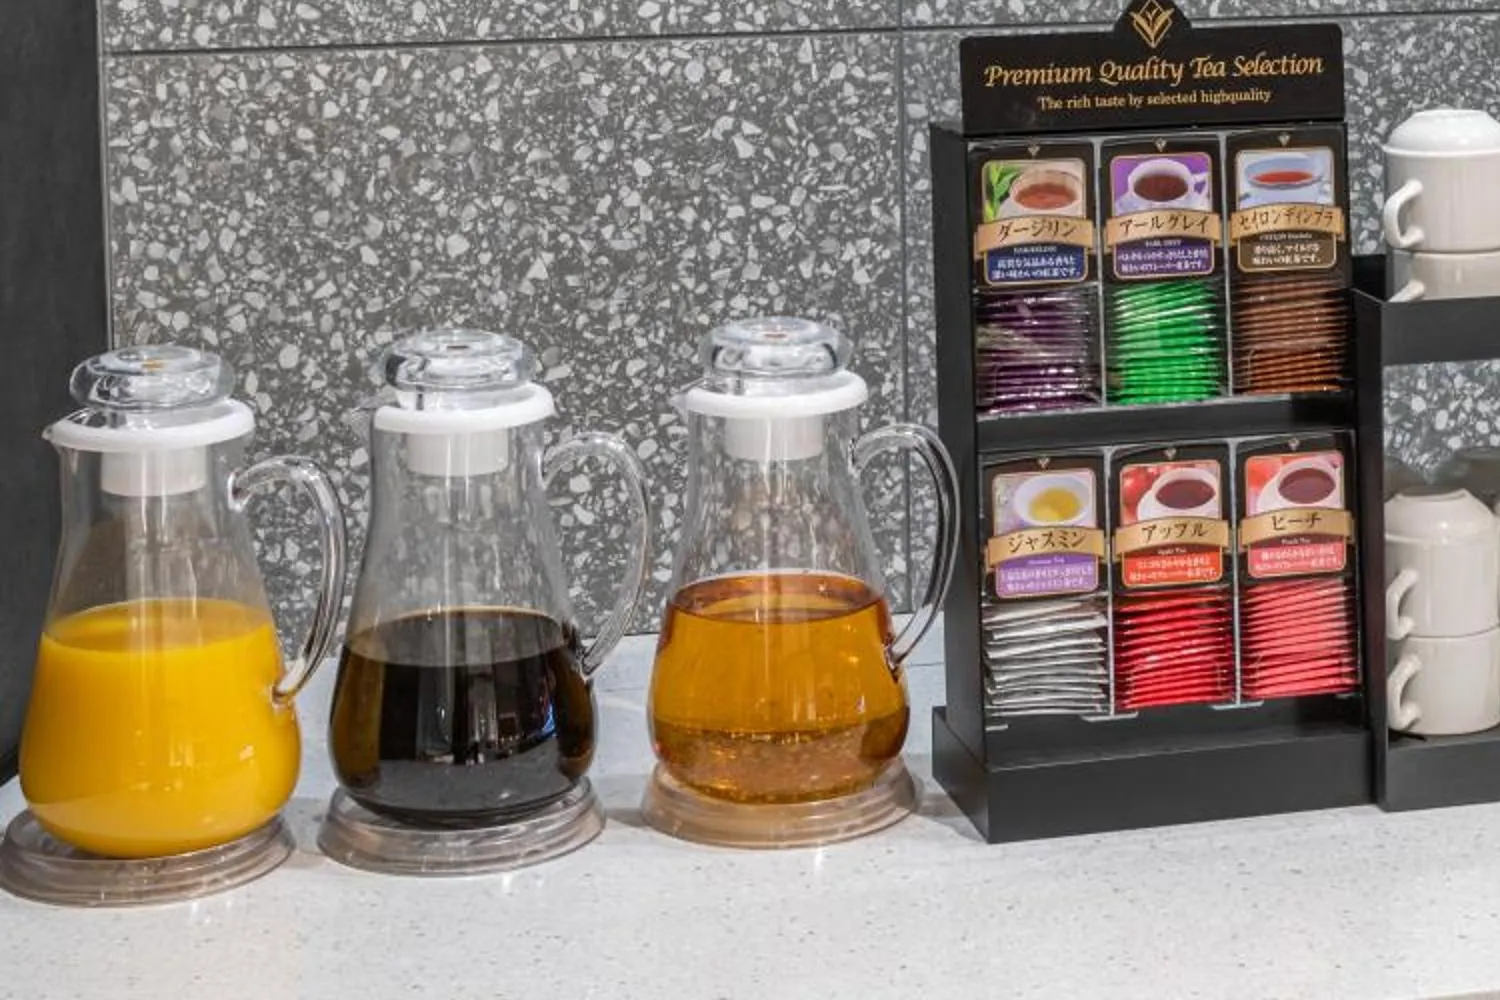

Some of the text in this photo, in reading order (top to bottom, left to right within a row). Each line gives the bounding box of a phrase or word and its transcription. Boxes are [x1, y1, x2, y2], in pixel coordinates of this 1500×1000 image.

[984, 51, 1325, 87] Premium Quality Tea Selection
[1037, 87, 1272, 110] The rich taste by selected highquality
[999, 219, 1077, 242] ダージリン
[1120, 213, 1209, 234] アールグレイ
[1008, 530, 1087, 553] ジャスミン
